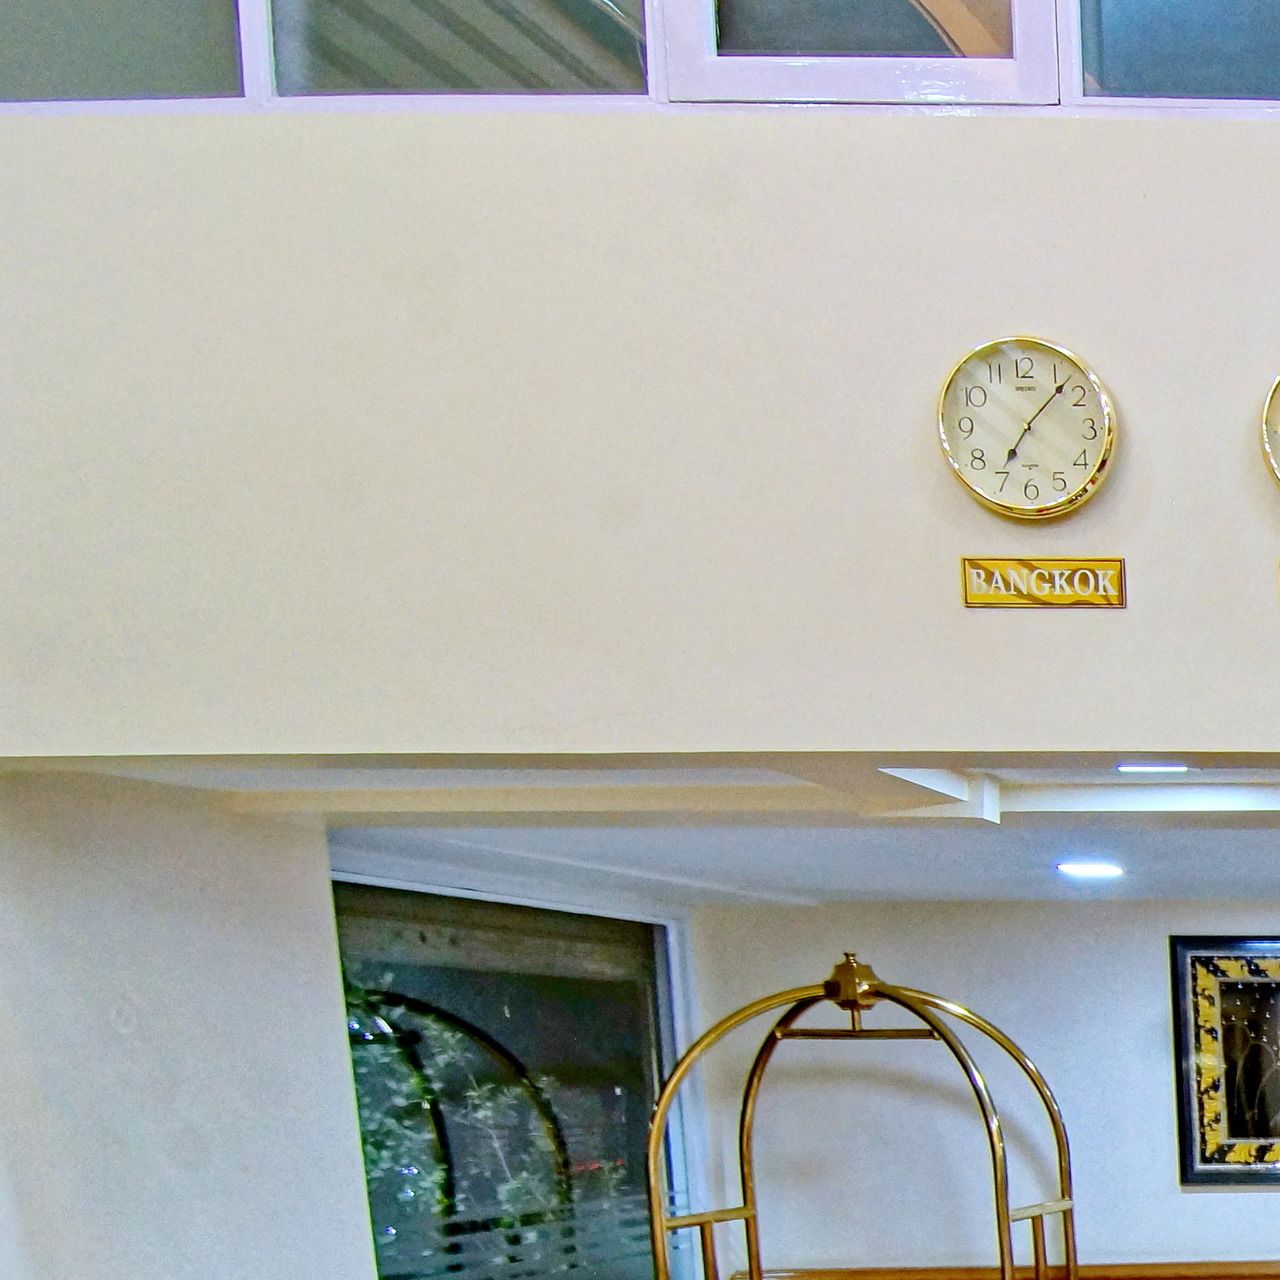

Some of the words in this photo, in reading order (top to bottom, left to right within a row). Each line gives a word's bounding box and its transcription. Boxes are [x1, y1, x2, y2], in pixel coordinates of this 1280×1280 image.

[988, 364, 1002, 383] 11
[1015, 357, 1034, 378] 12
[965, 385, 987, 407] 10
[1071, 385, 1086, 407] 2
[959, 416, 973, 440] 9
[1082, 418, 1097, 440] 3
[970, 448, 986, 470] 8
[1073, 449, 1089, 470] 4
[994, 471, 1010, 492] 7
[1024, 478, 1039, 500] 6
[1052, 471, 1066, 491] 5
[970, 569, 1118, 597] BANGKOK
